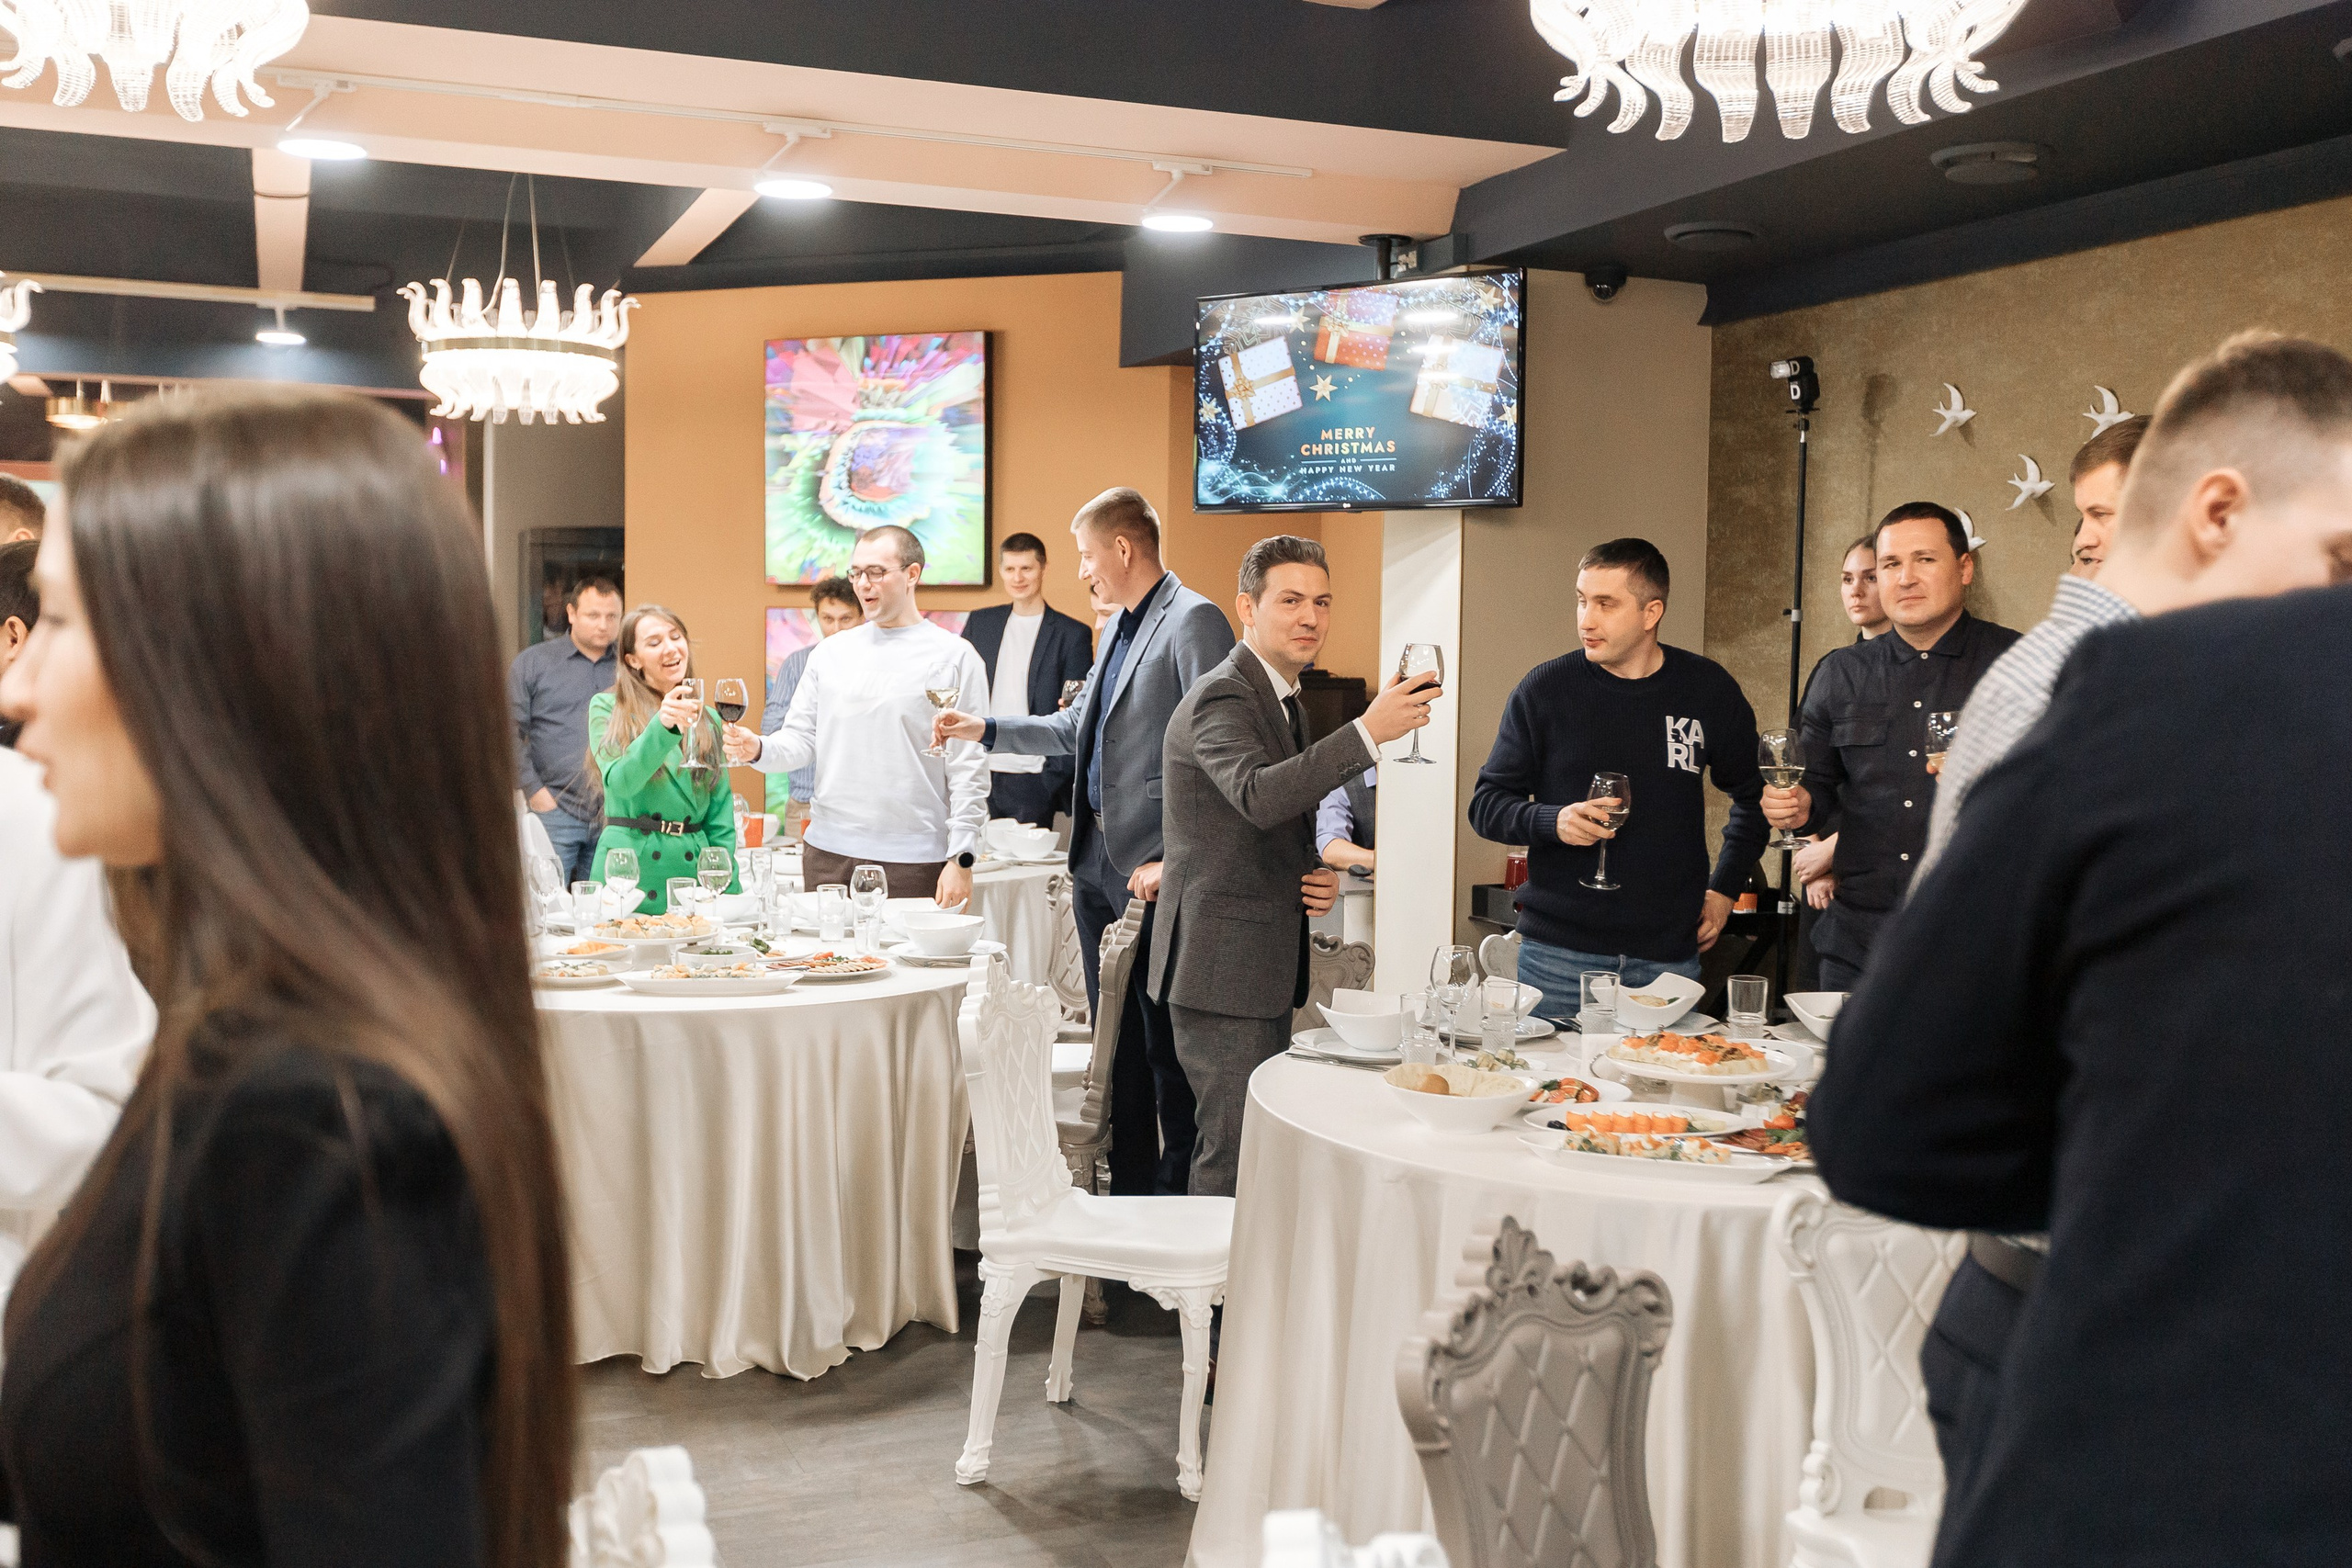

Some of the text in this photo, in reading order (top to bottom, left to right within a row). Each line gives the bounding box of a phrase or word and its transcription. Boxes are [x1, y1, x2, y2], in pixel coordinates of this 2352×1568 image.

[1321, 426, 1375, 441] MERRY
[1300, 440, 1396, 456] CHRISTMAS
[1300, 464, 1396, 475] HAPPY NEW YEAR
